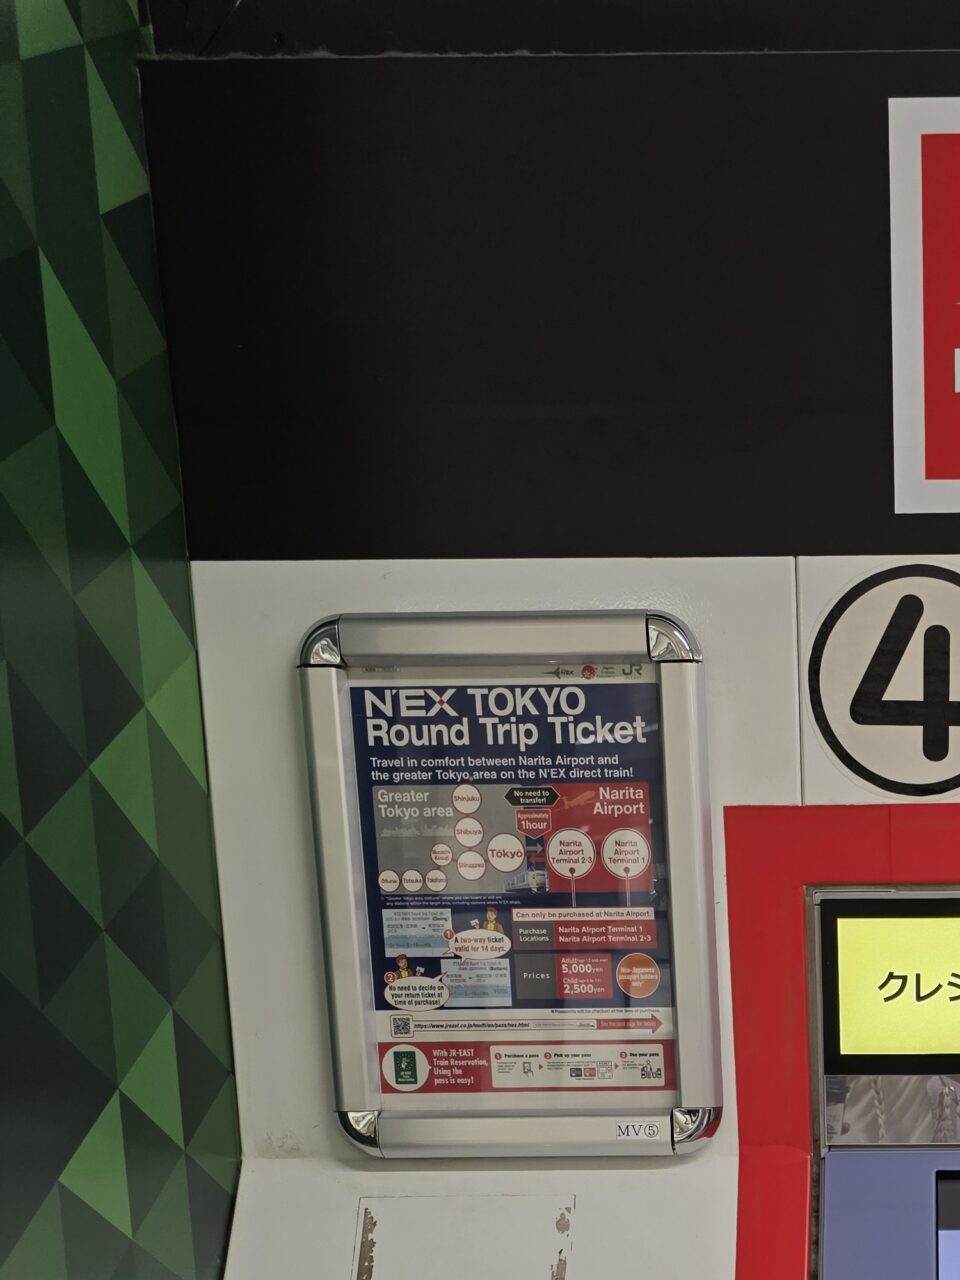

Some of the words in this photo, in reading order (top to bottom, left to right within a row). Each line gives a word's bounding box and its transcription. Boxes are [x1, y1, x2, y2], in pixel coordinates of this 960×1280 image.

[364, 688, 459, 717] N'EX
[467, 686, 586, 717] TOKYO
[366, 717, 470, 746] Round
[478, 716, 539, 752] Trip
[547, 715, 647, 745] Ticket
[370, 757, 404, 767] Travel
[408, 757, 417, 767] in
[420, 756, 465, 767] comfort
[468, 756, 516, 766] between
[519, 755, 552, 765] Narita
[555, 755, 594, 767] Airport
[597, 754, 619, 765] and
[371, 770, 390, 780] the
[392, 771, 432, 782] greater
[435, 770, 469, 782] Tokyo
[472, 771, 497, 780] area
[500, 771, 515, 779] on
[518, 768, 536, 779] the
[539, 768, 566, 779] N'EX
[569, 768, 602, 778] direct
[605, 767, 633, 777] train!
[377, 789, 430, 802] Greater
[599, 786, 643, 799] Narita
[378, 804, 420, 820] Tokyo
[423, 807, 454, 817] area
[593, 802, 645, 817] Airport
[615, 839, 638, 847] Narita
[558, 849, 584, 857] Airport
[614, 849, 640, 857] Airport
[551, 856, 579, 864] Terminal
[608, 856, 638, 864] Terminal
[531, 911, 545, 920] only
[558, 911, 594, 920] purchased
[603, 910, 625, 918] Narita
[625, 910, 651, 919] Airport.
[581, 926, 606, 935] Airport
[582, 935, 606, 944] Airport
[561, 963, 592, 974] 5,000
[563, 984, 594, 995] 2,500
[432, 1049, 448, 1057] With
[449, 1049, 474, 1057] JR-EAST
